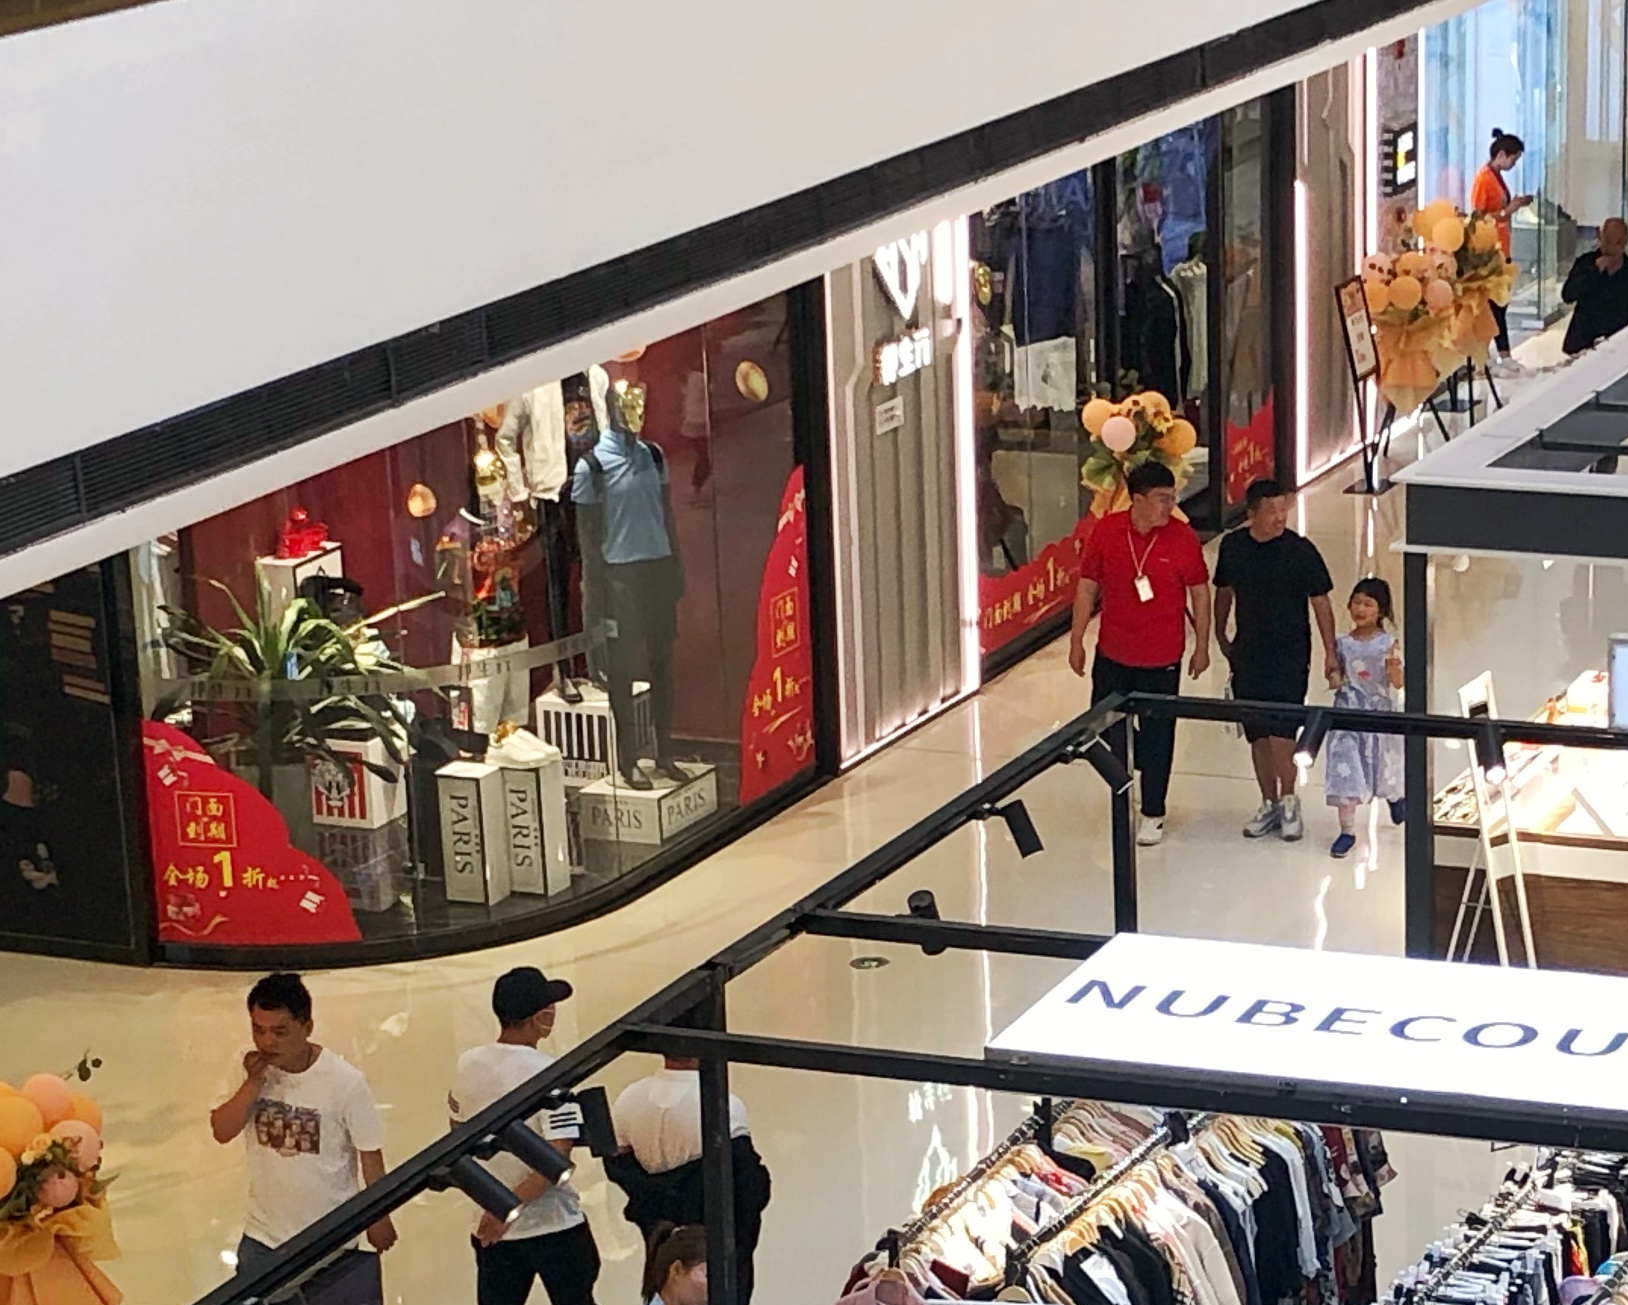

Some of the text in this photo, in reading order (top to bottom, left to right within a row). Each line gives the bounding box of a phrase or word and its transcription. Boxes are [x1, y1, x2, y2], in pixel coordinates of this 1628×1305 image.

[449, 793, 475, 876] PARIS
[508, 788, 533, 869] PARIS
[590, 805, 643, 831] PARIS
[666, 791, 707, 822] PARIS
